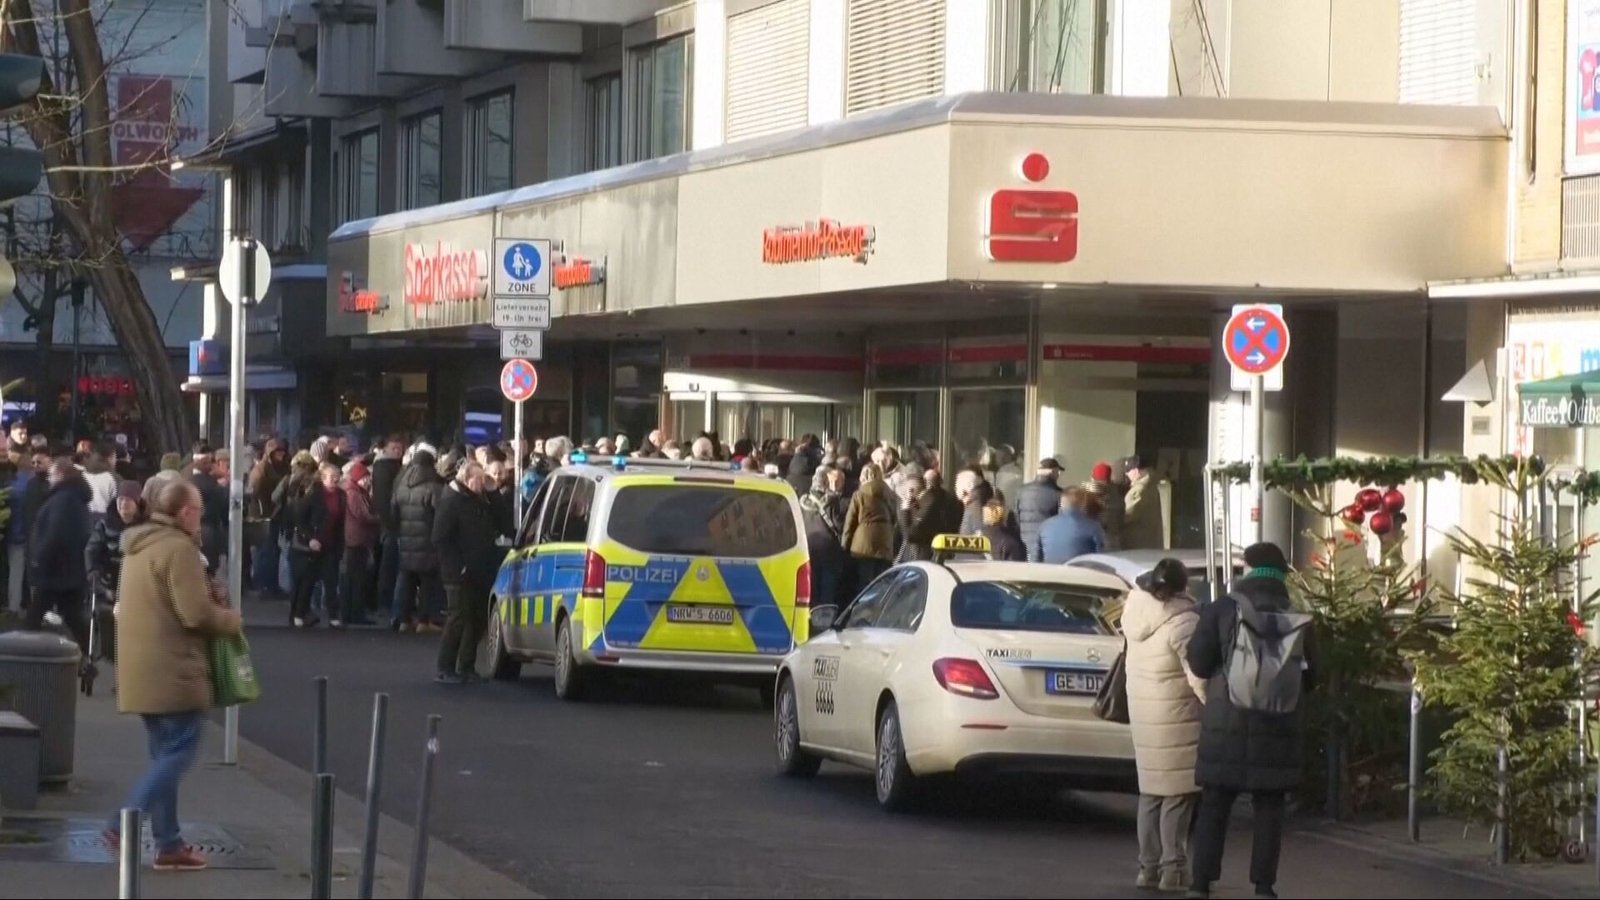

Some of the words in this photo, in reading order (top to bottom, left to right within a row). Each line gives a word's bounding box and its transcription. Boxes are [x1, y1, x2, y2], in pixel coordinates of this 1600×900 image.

[404, 239, 482, 319] Sparkasse
[508, 282, 536, 293] ZONE
[496, 303, 547, 312] Lieferverkehr
[528, 314, 542, 322] frei
[1522, 397, 1559, 425] Kaffee
[946, 537, 983, 548] TAXI
[608, 566, 678, 584] POLIZEI
[1056, 673, 1076, 690] GE
